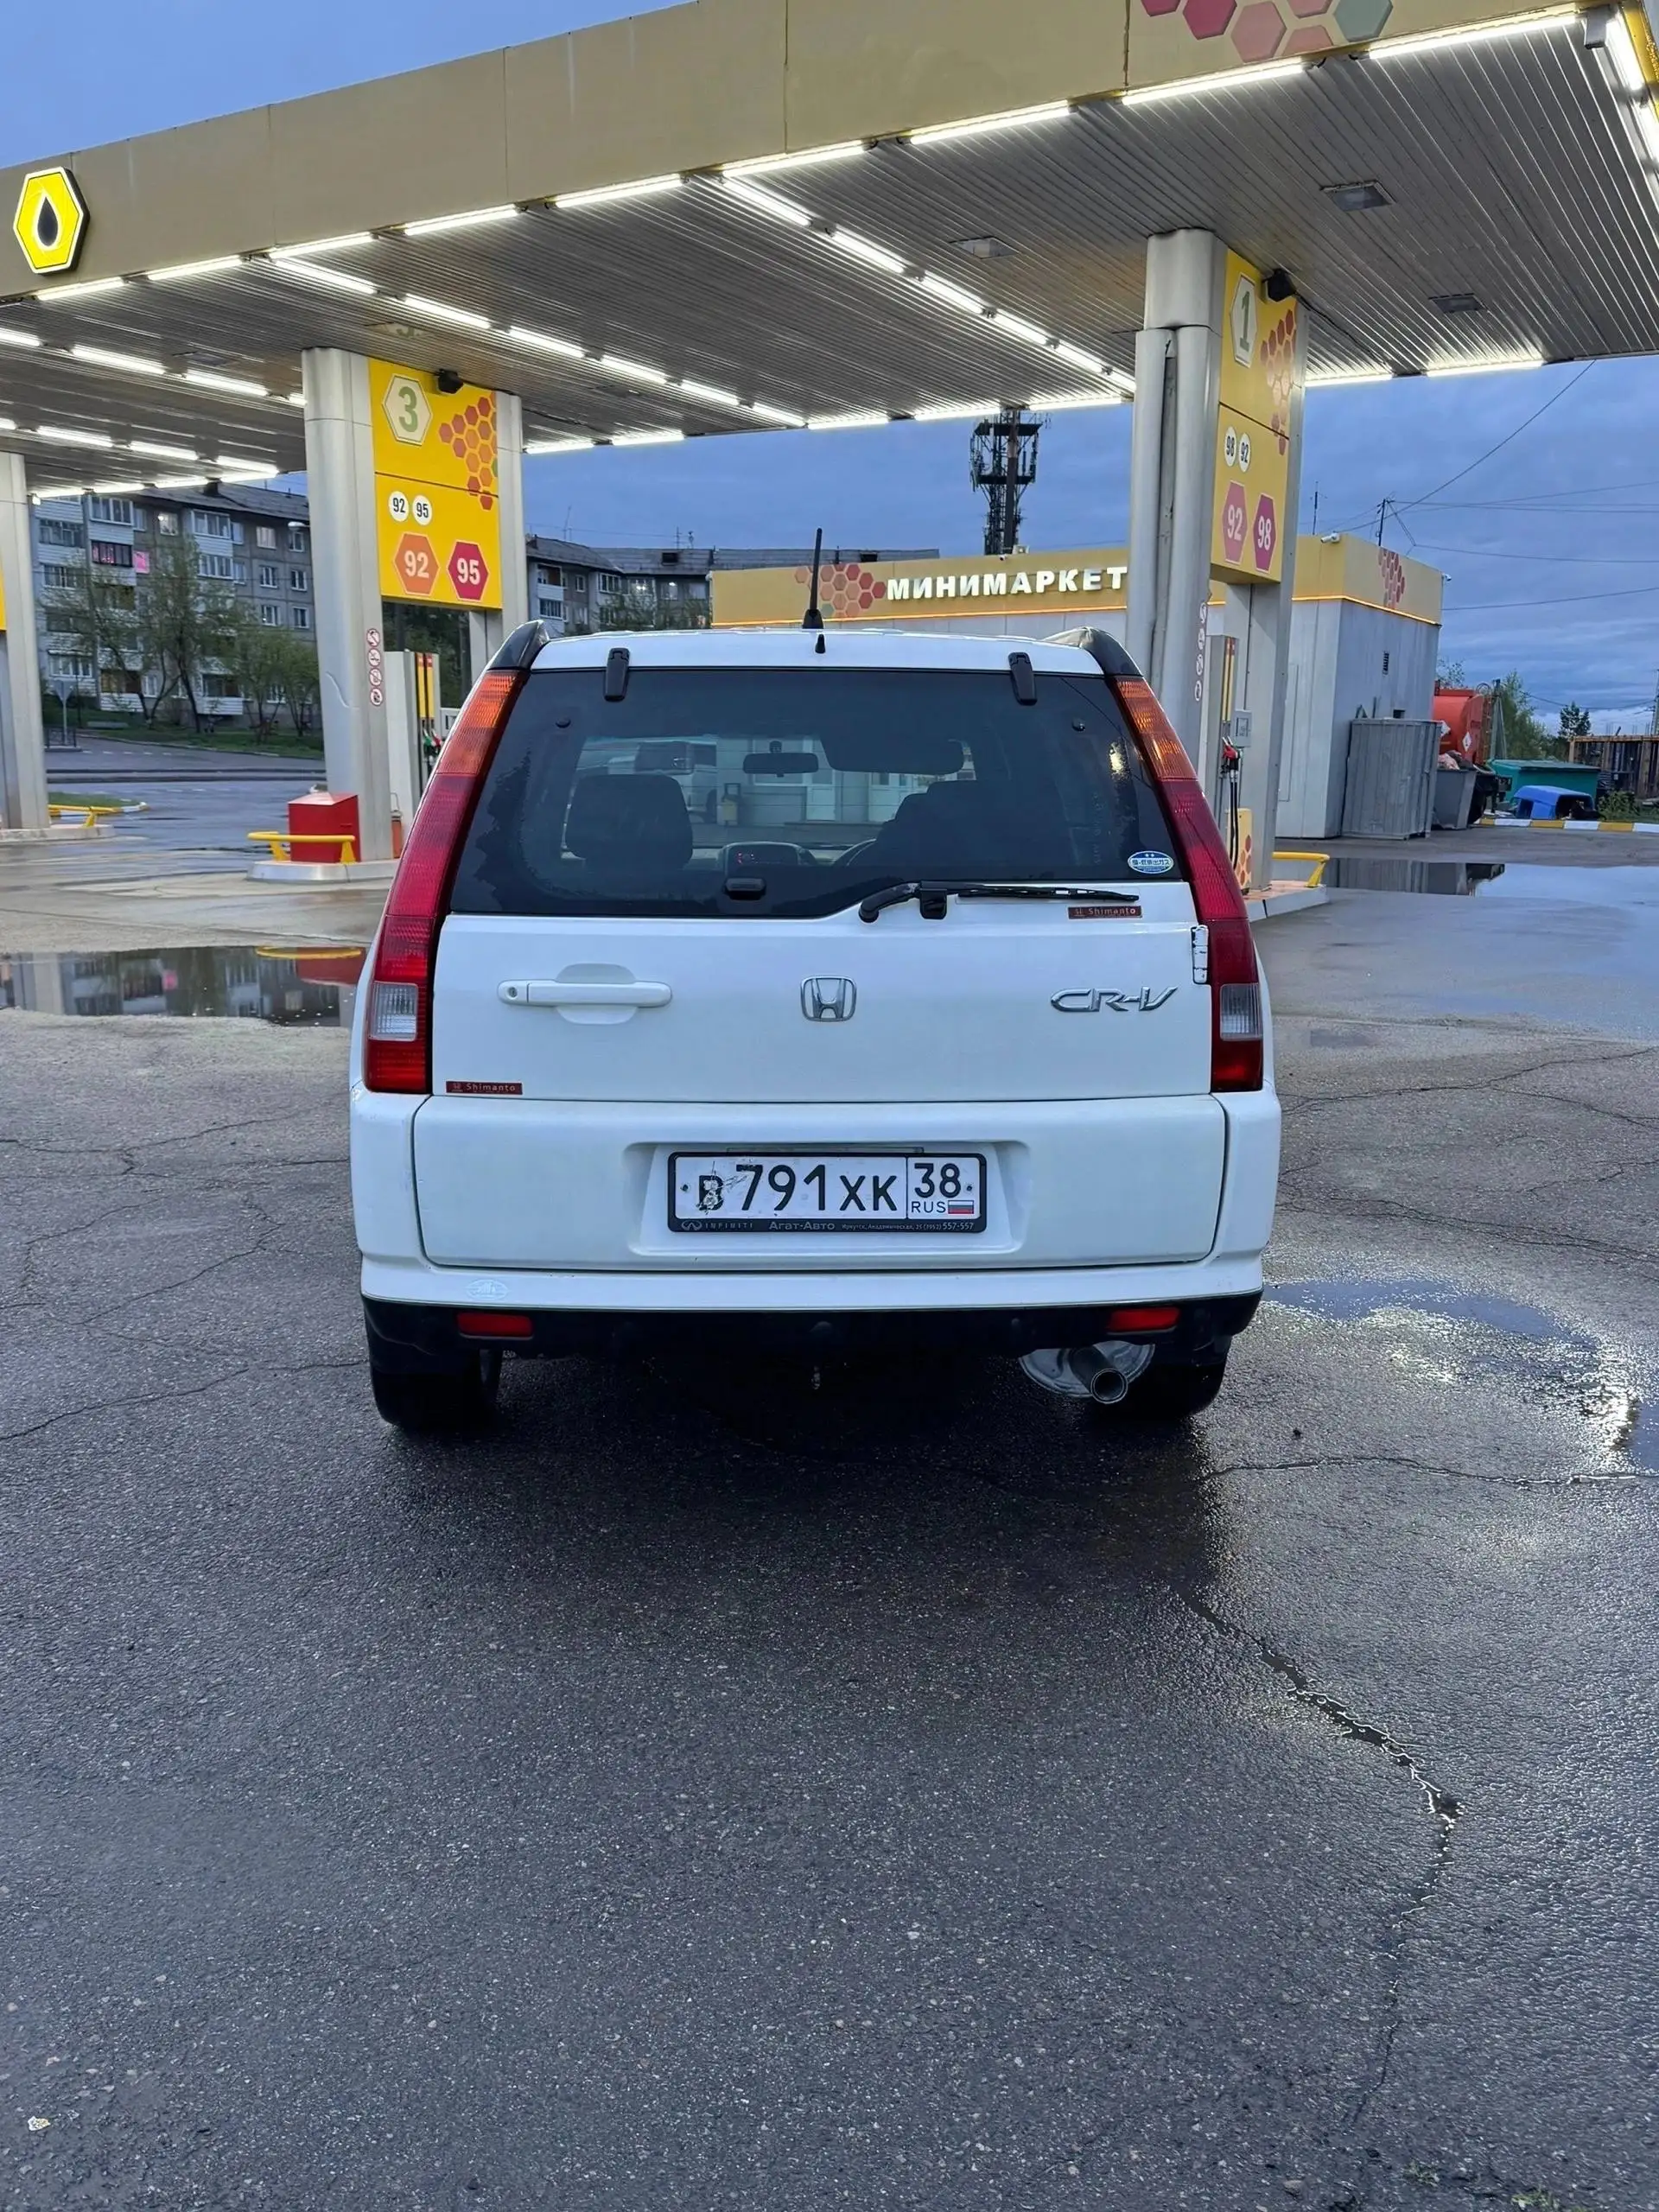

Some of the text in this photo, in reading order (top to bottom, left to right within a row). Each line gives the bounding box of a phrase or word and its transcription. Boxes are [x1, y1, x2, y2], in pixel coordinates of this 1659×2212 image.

[1239, 291, 1250, 353] 1
[397, 386, 419, 433] 3
[1225, 435, 1249, 464] 98 92
[392, 497, 429, 518] 92 95
[1227, 504, 1243, 541] 92
[1257, 515, 1272, 550] 98
[404, 550, 429, 579] 92
[456, 557, 480, 586] 95
[887, 566, 1128, 601] МИНИМАРКЕТ
[1088, 906, 1136, 916] Shimanto
[1050, 986, 1179, 1012] CR-V
[466, 1083, 516, 1092] Shimanto
[913, 1162, 962, 1198] 38
[911, 1200, 946, 1213] RUS
[943, 1221, 975, 1231] 557-557
